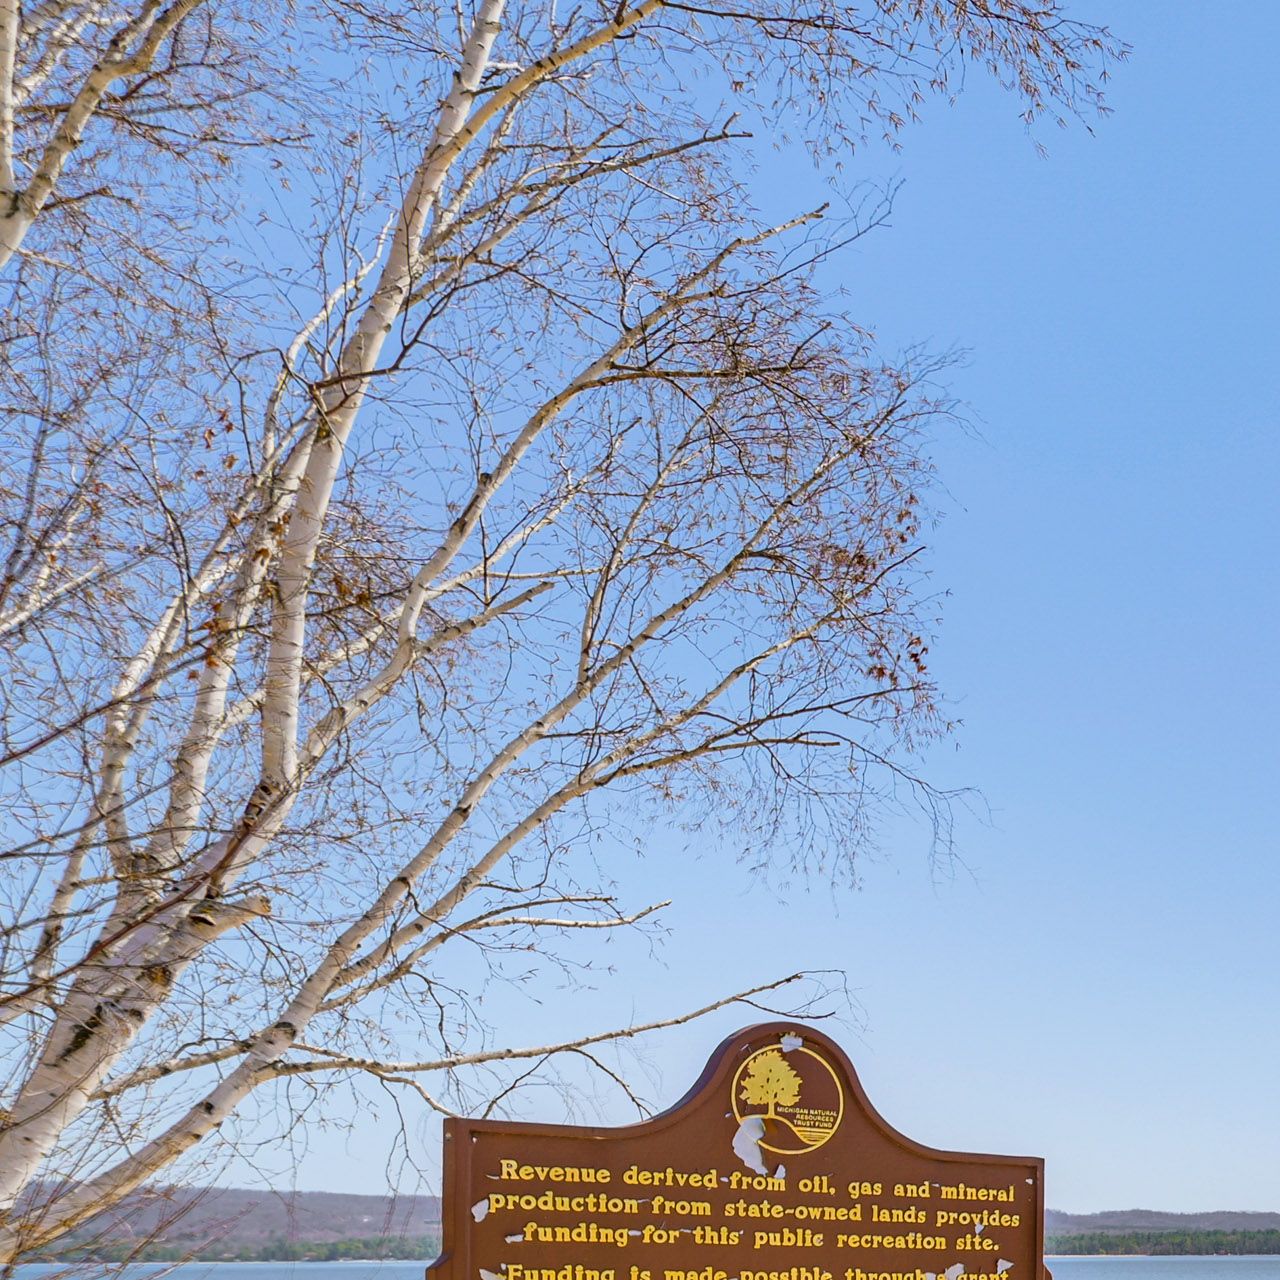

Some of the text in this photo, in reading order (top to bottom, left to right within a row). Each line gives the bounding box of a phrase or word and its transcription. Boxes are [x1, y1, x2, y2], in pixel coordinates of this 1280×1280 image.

[777, 1106, 837, 1116] MICHIGAN NATURAL
[795, 1114, 834, 1122] RESOURCES
[501, 1160, 1014, 1201] Revenue derived from oil, gas and mineral
[489, 1191, 1019, 1226] production from state-owned lands provides
[524, 1222, 999, 1250] funding for this public recreation site.
